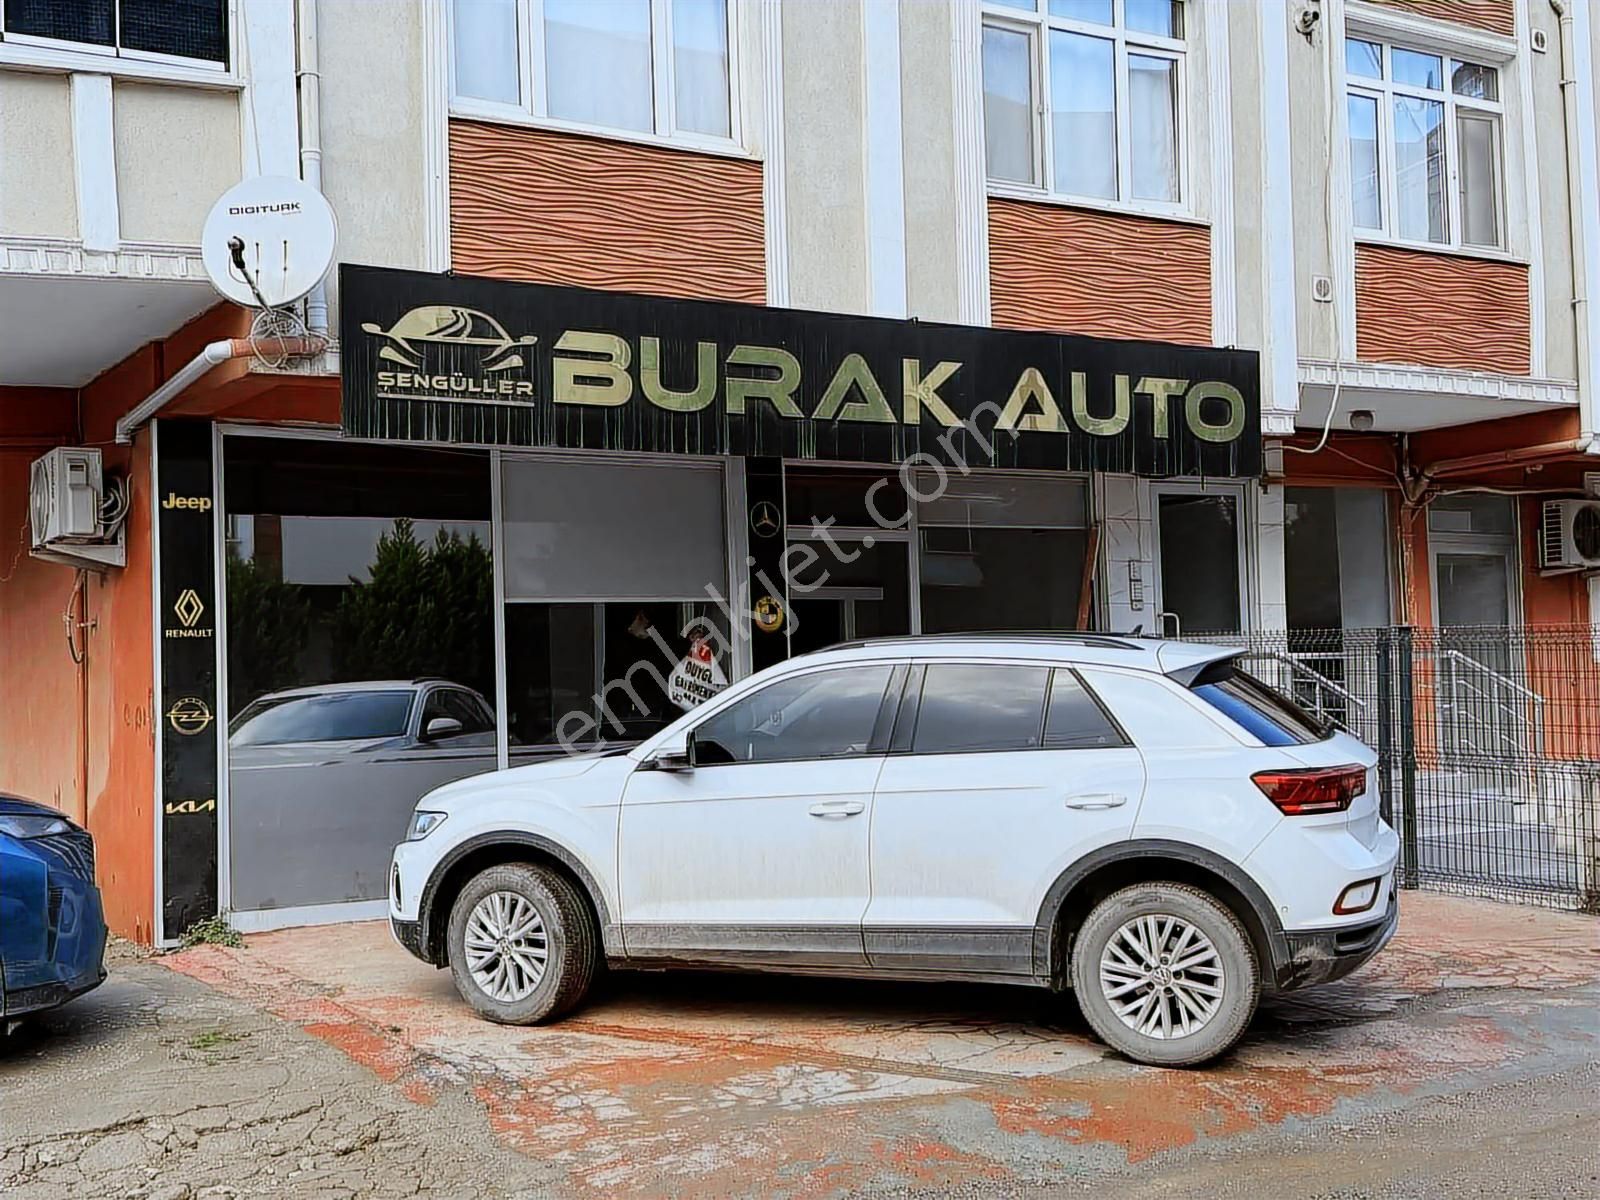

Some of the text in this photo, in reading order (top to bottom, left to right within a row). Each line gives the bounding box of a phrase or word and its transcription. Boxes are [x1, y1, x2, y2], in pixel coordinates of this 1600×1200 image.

[229, 202, 301, 215] DIGITURK
[377, 371, 534, 396] ŞENGÜLLER
[553, 330, 1246, 443] BURAK AUTO
[162, 492, 212, 513] Jeep
[165, 629, 213, 639] RENAULT
